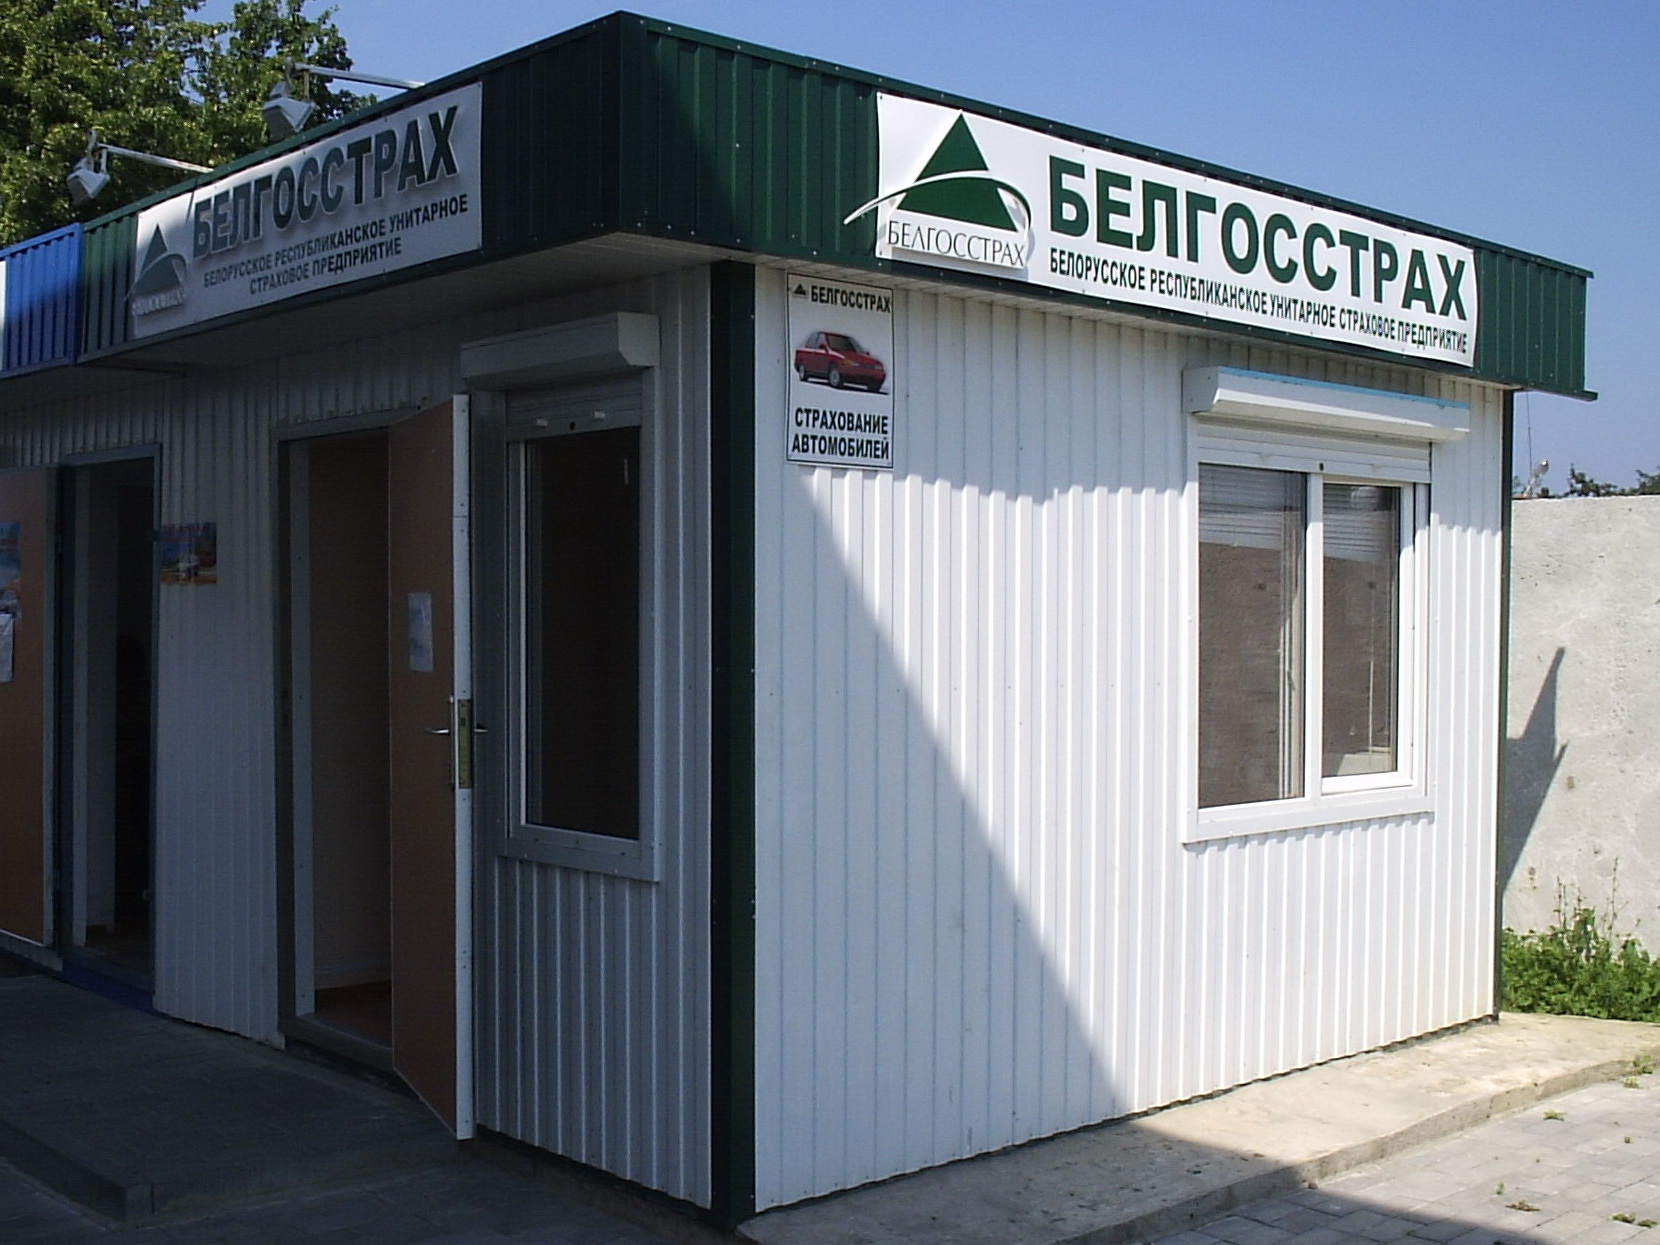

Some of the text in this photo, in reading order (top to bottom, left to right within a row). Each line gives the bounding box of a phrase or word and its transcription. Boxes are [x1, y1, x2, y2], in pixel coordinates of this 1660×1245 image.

[194, 105, 459, 260] БЕЛГОССТРАХ
[203, 193, 468, 288] БЕЛОРУССКОЕ РЕСПУБЛИКАНСКОЕ УНИТАРНОЕ
[249, 237, 402, 295] СТРАХОВОЕ ПРЕДПРИЯТИЕ
[887, 219, 1025, 267] БЕЛГОССТРАХ
[1049, 154, 1468, 322] БЕЛГОССТРАХ
[810, 285, 891, 313] БЕЛГОССТРАХ
[1050, 247, 1468, 354] БЕЛОРУССКОЕ РЕСПУБЛИКАНСКОЕ УНИТАРНОЕ СТРАХОВОЕ ПРЕДПРИЯТИЕ
[791, 433, 890, 461] АВТОМОБИЛЕЙ
[794, 407, 889, 435] СТРАХОВАНИЕ
